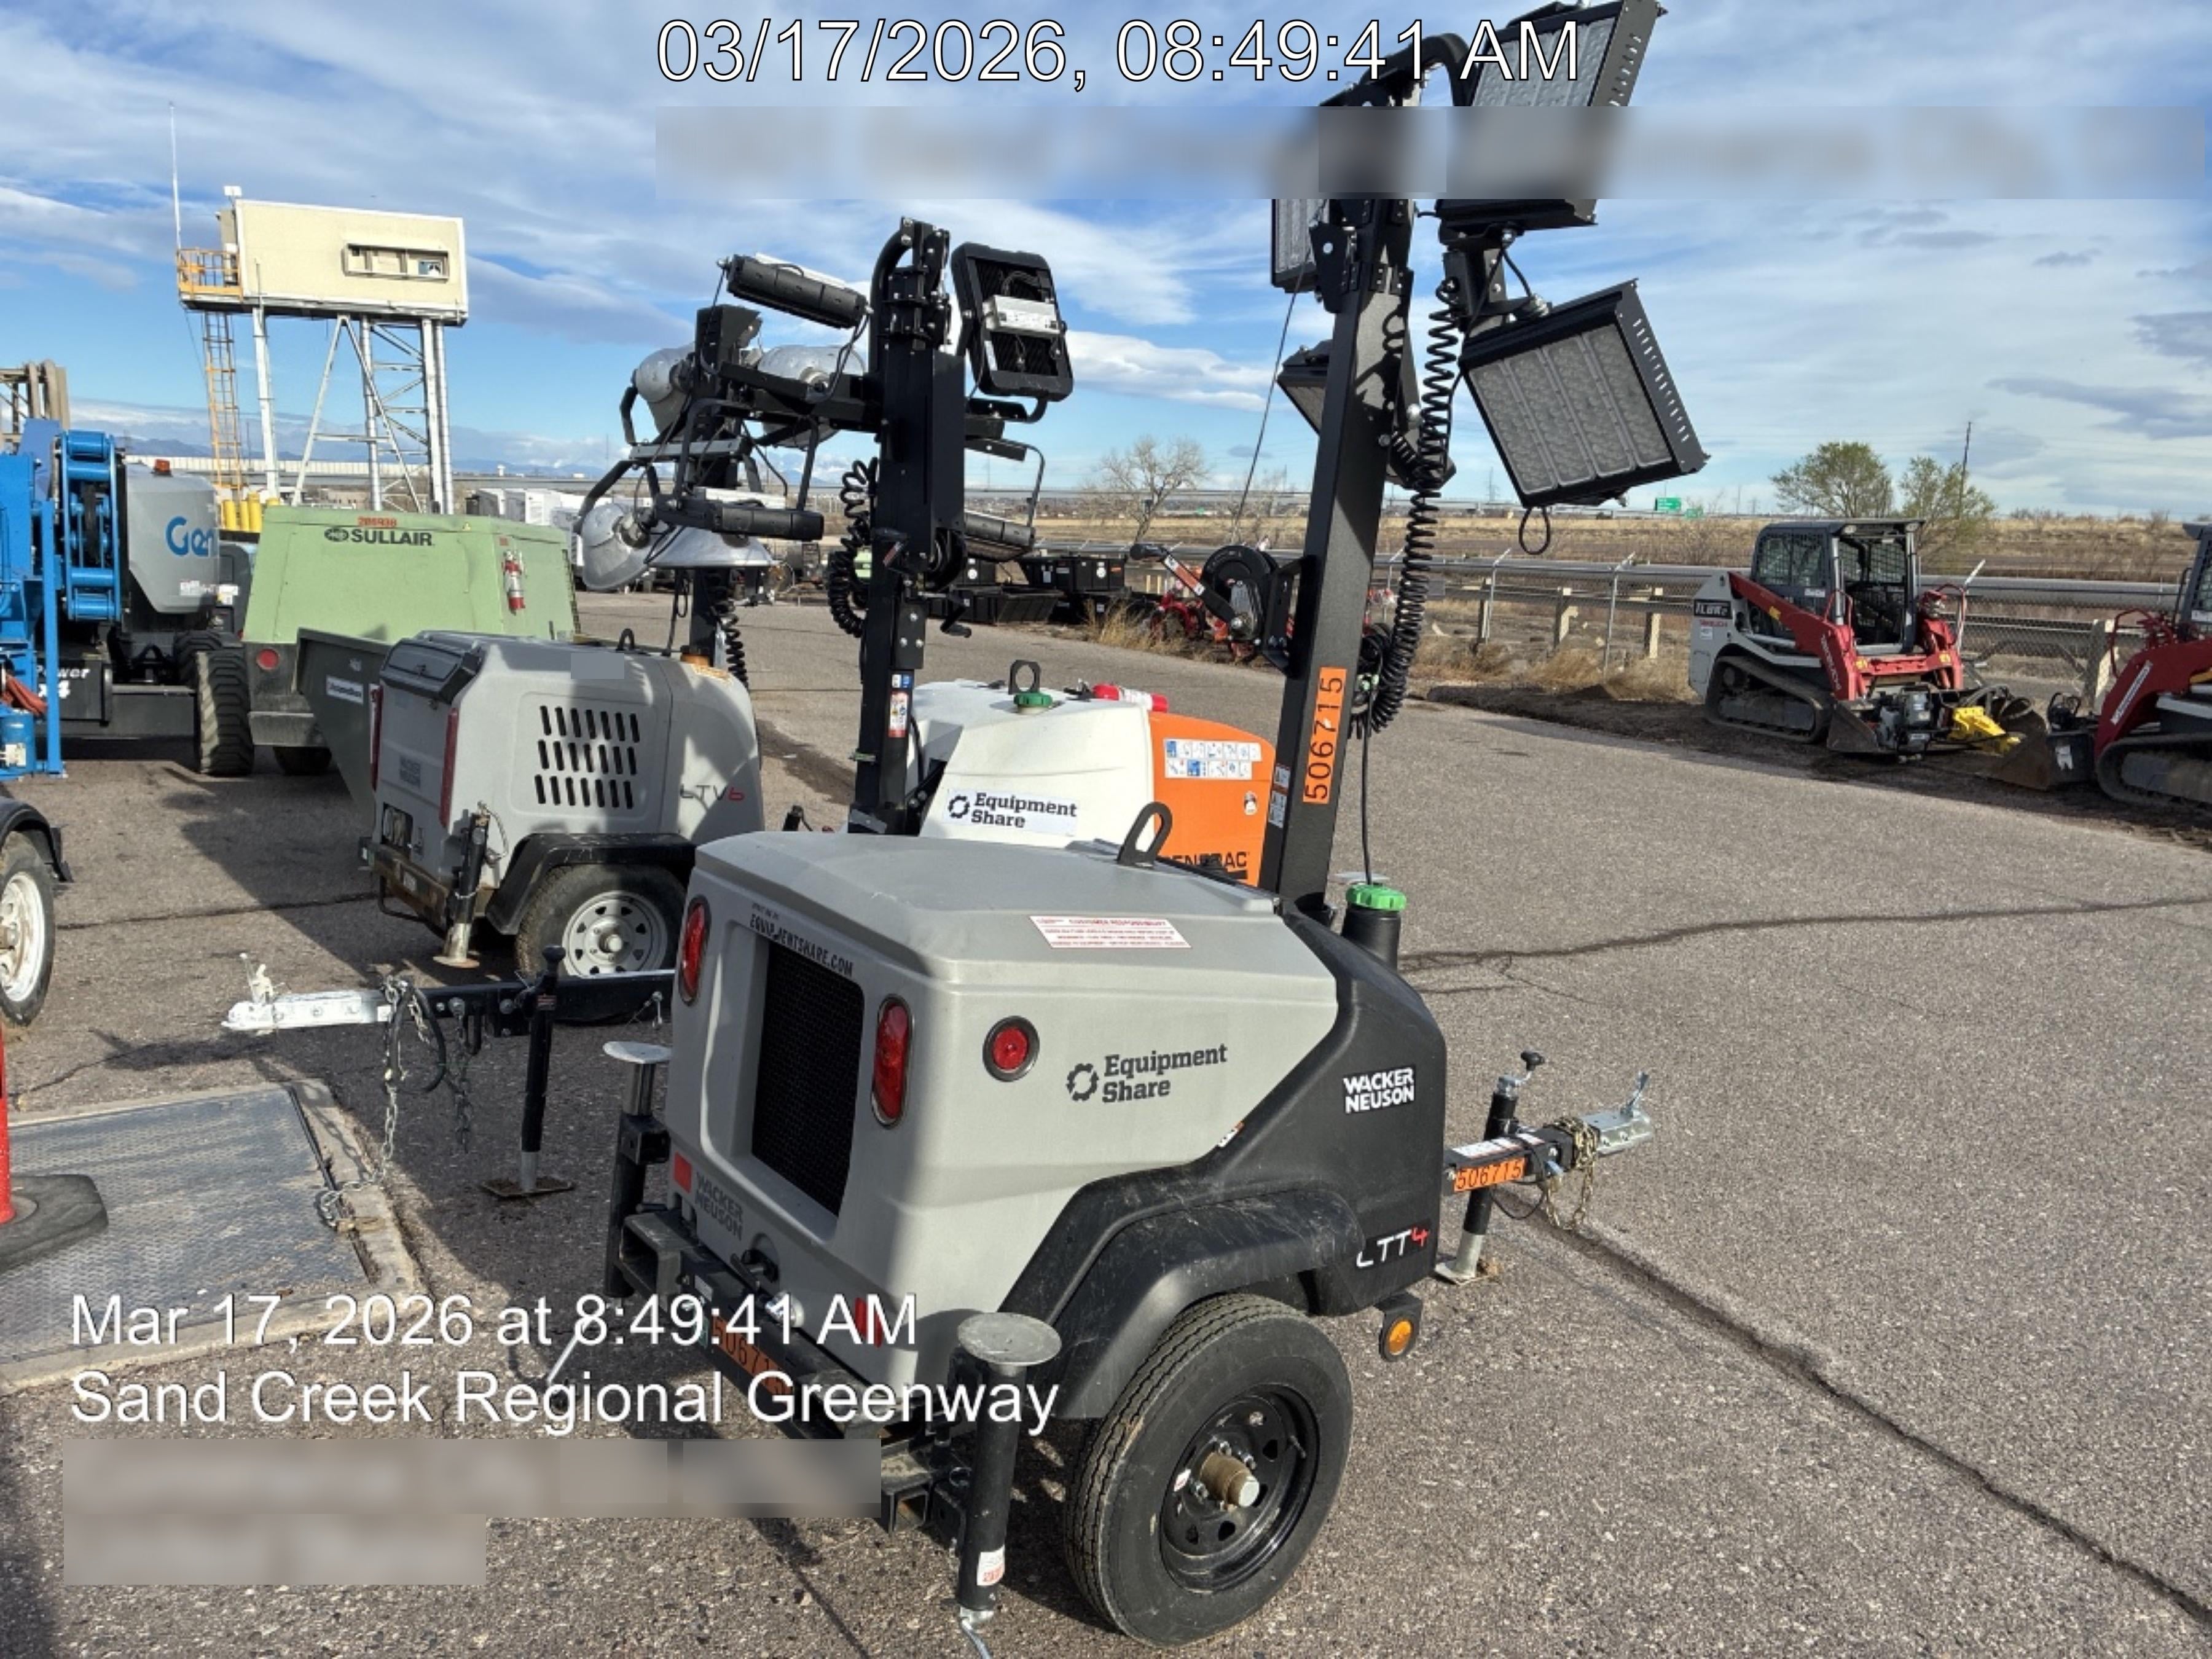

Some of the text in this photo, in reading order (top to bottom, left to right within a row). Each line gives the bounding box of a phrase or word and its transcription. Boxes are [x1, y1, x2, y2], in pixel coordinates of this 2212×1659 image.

[351, 528, 433, 546] SULLAIR
[36, 665, 90, 679] Pwer
[1304, 677, 1343, 799] 506715
[974, 792, 1077, 817] Equipment
[971, 809, 1026, 828] Share
[1104, 1043, 1228, 1079] Equipment
[1102, 1080, 1171, 1103] Share
[1343, 1067, 1414, 1094] WACKER
[1345, 1085, 1414, 1114] NEUSON
[1457, 1160, 1521, 1189] 506715
[1356, 1227, 1429, 1268] LTT4
